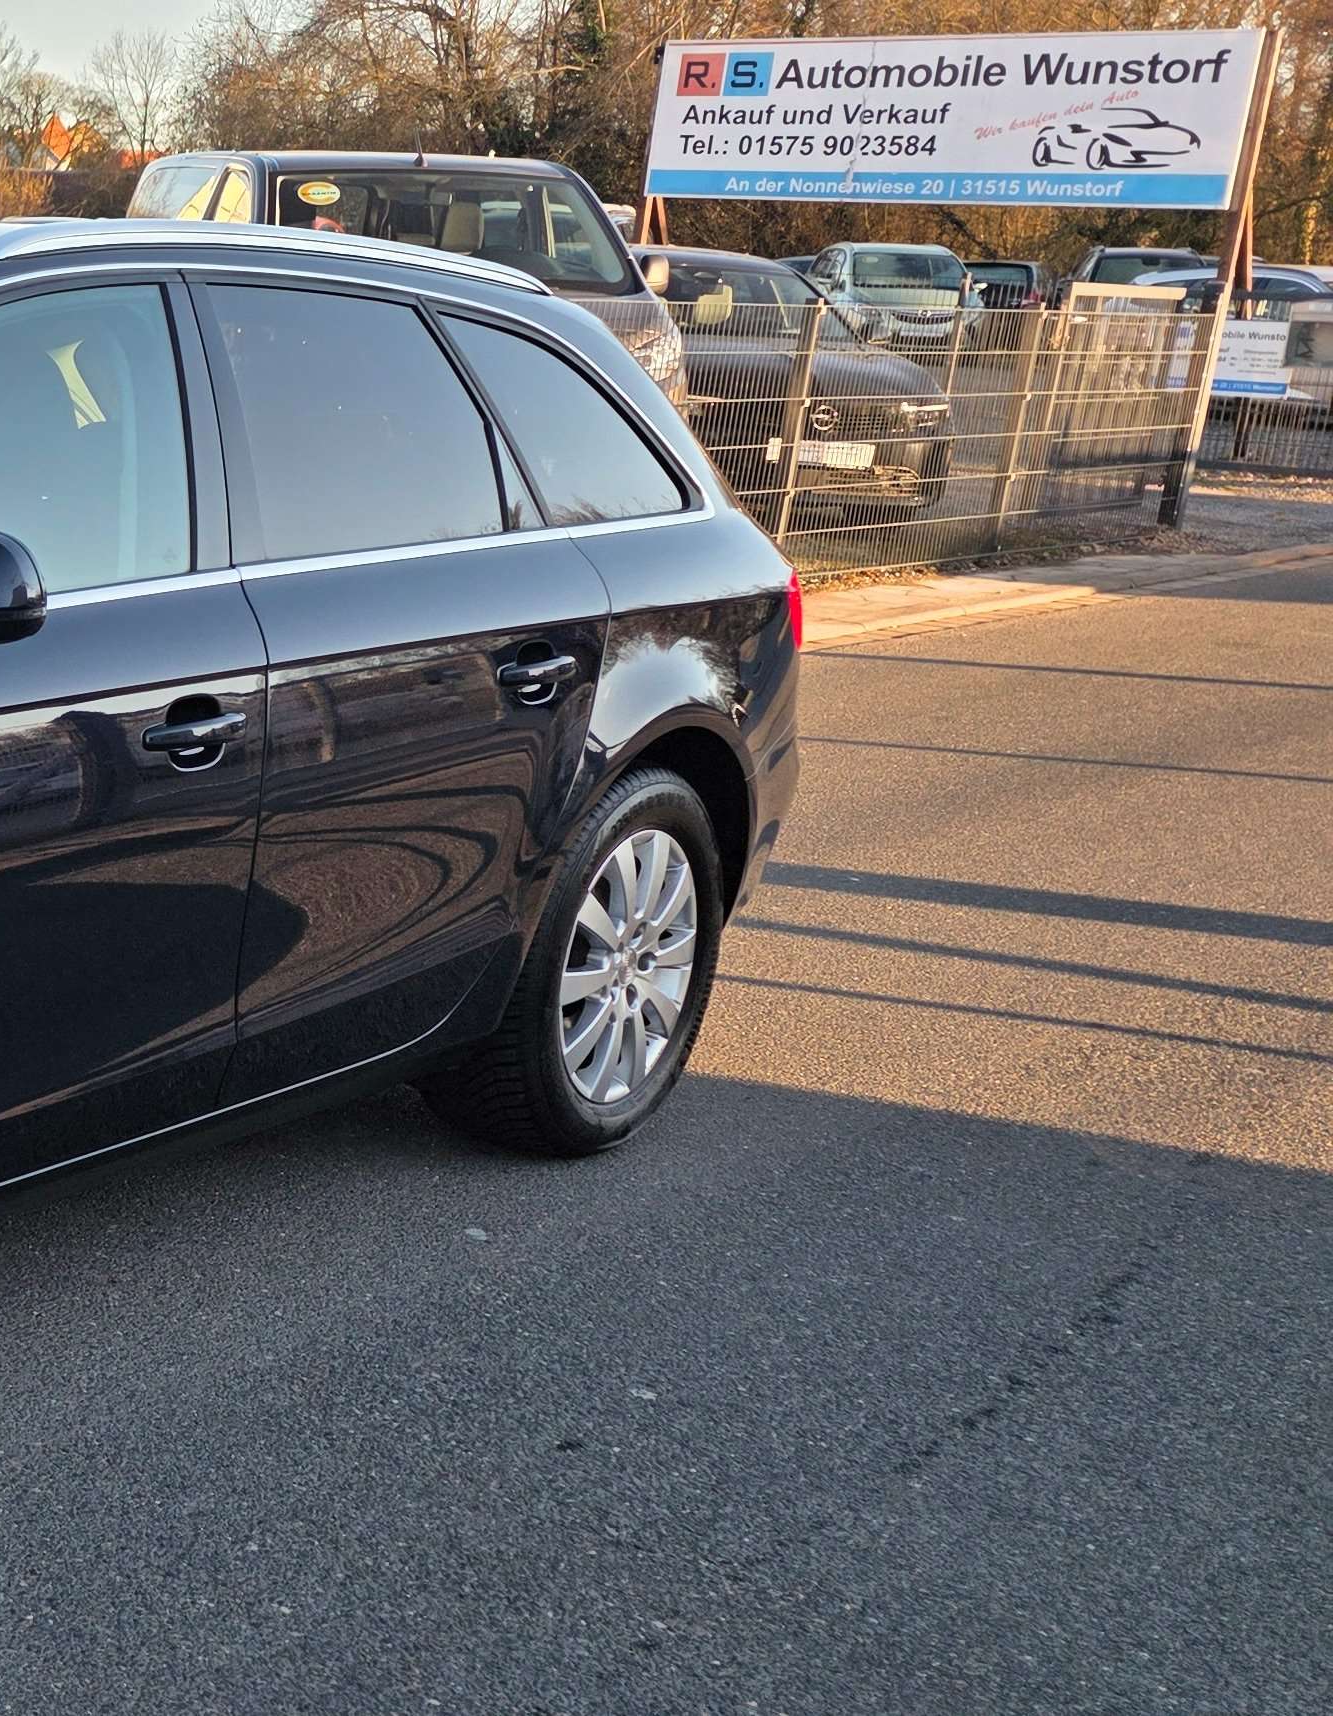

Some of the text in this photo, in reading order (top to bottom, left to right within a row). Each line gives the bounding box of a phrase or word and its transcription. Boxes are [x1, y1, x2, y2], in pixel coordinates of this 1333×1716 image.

[775, 55, 1007, 89] Automobile
[1023, 49, 1232, 86] Wunstorf
[681, 102, 952, 125] Ankauf und Verkauf
[974, 89, 1140, 140] Wir kaufen dein Auto
[679, 134, 729, 155] Tel.:
[738, 135, 815, 156] 01575
[725, 176, 750, 192] An
[755, 177, 784, 193] der
[789, 177, 915, 195] Nonnenwiese
[921, 179, 943, 195] 20
[961, 179, 1021, 195] 31515
[1026, 179, 1125, 196] Wunstorf
